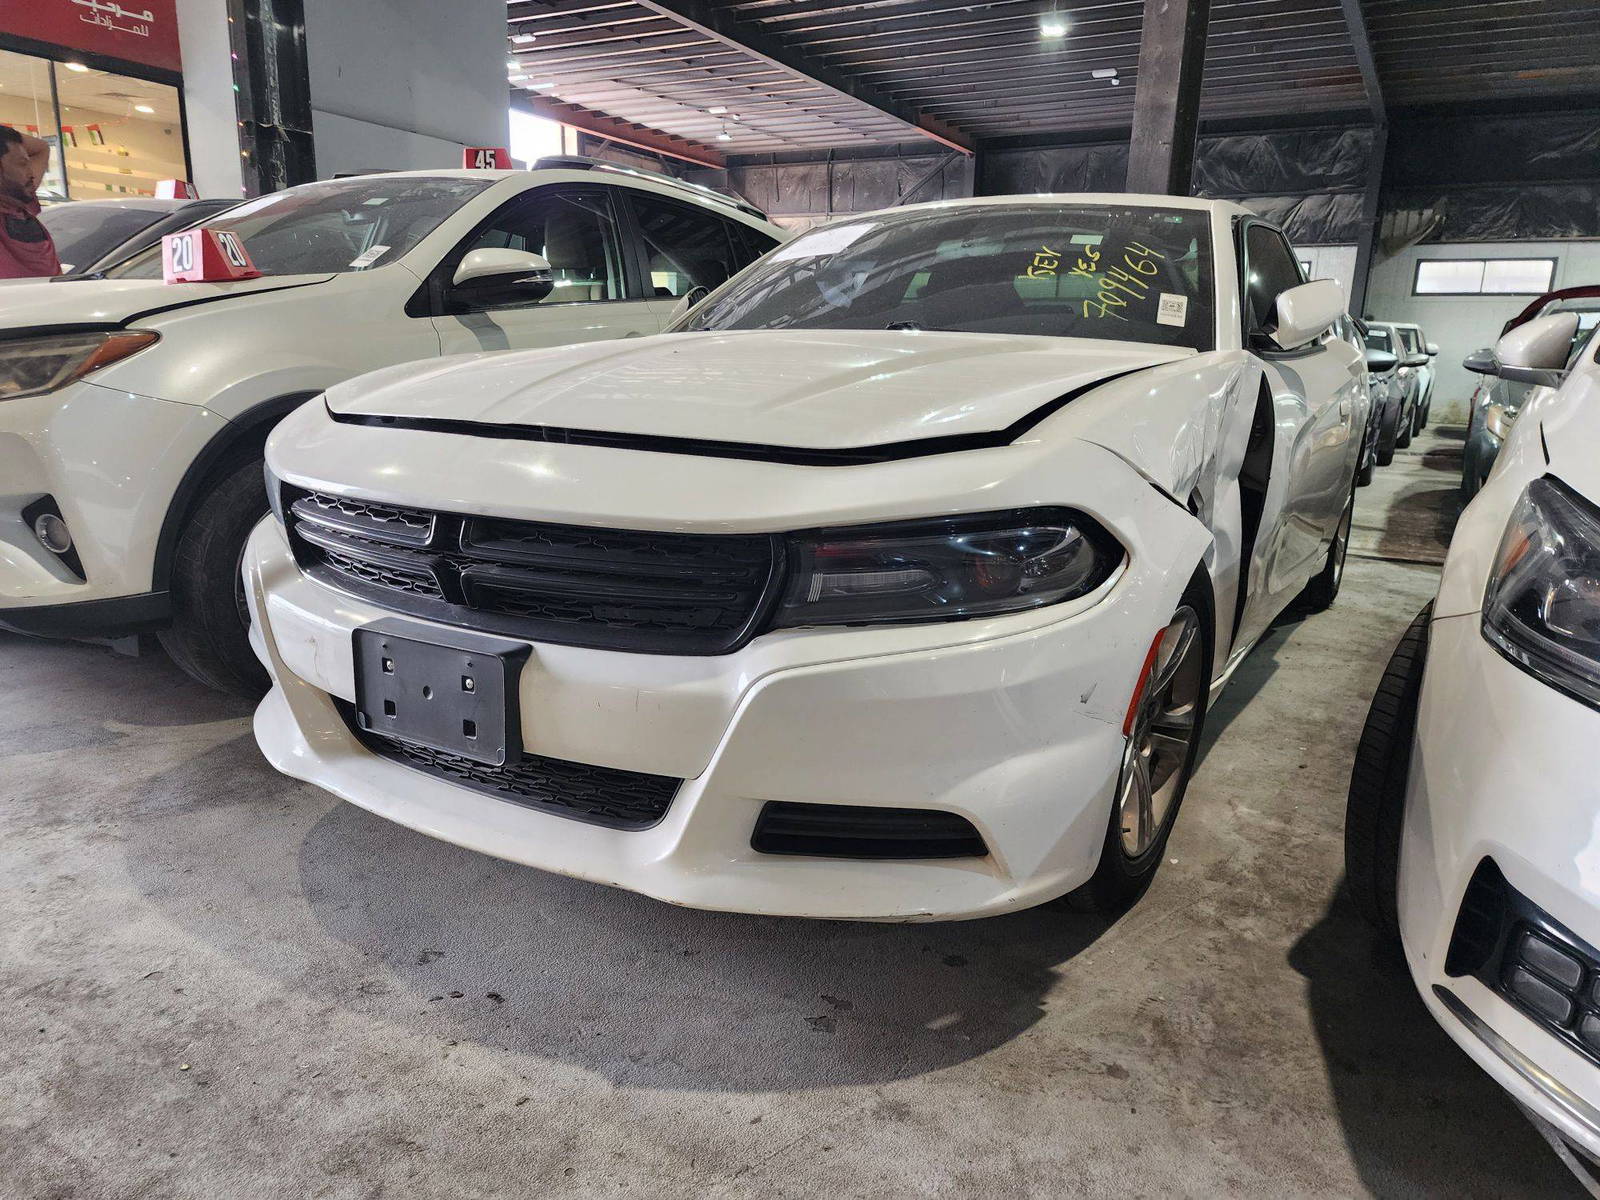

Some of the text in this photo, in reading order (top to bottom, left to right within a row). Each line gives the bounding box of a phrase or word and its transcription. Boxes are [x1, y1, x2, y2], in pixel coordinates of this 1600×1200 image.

[80, 11, 149, 37] للمزادات
[475, 150, 496, 169] 45
[172, 235, 193, 273] 20
[217, 233, 247, 266] 20
